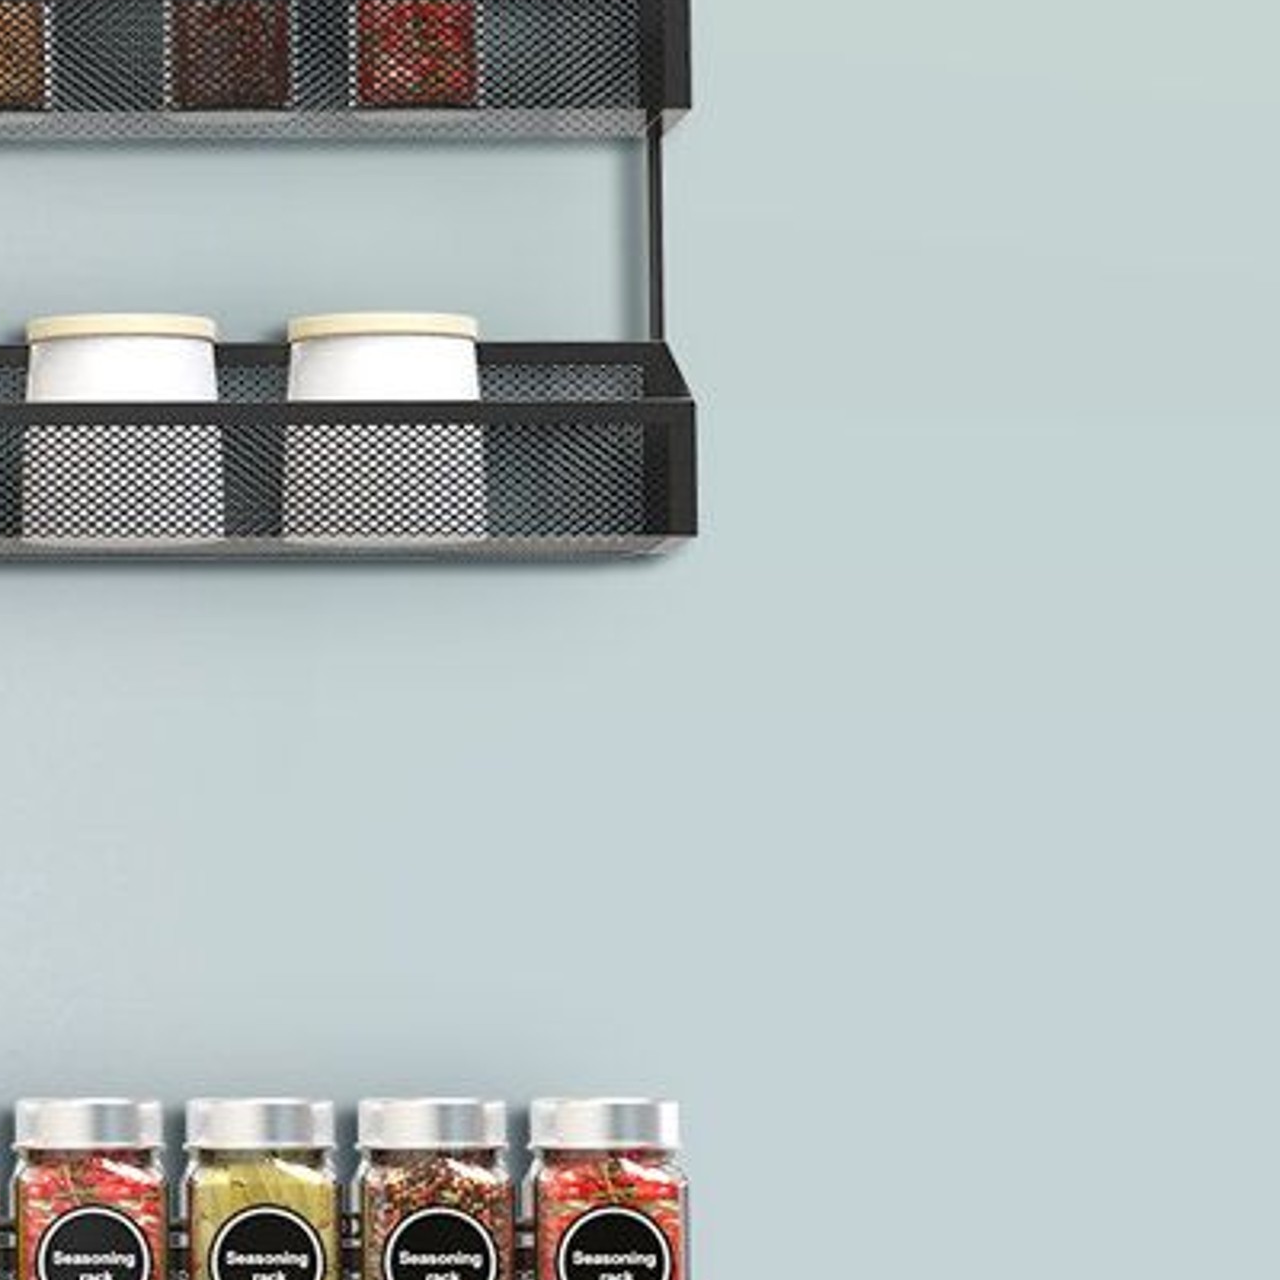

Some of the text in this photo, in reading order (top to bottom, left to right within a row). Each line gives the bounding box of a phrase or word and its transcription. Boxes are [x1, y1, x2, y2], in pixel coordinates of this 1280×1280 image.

[52, 1250, 136, 1269] Seasoning
[226, 1250, 309, 1269] Seasoning
[399, 1250, 483, 1269] Seasoning
[572, 1250, 657, 1269] Seasoning
